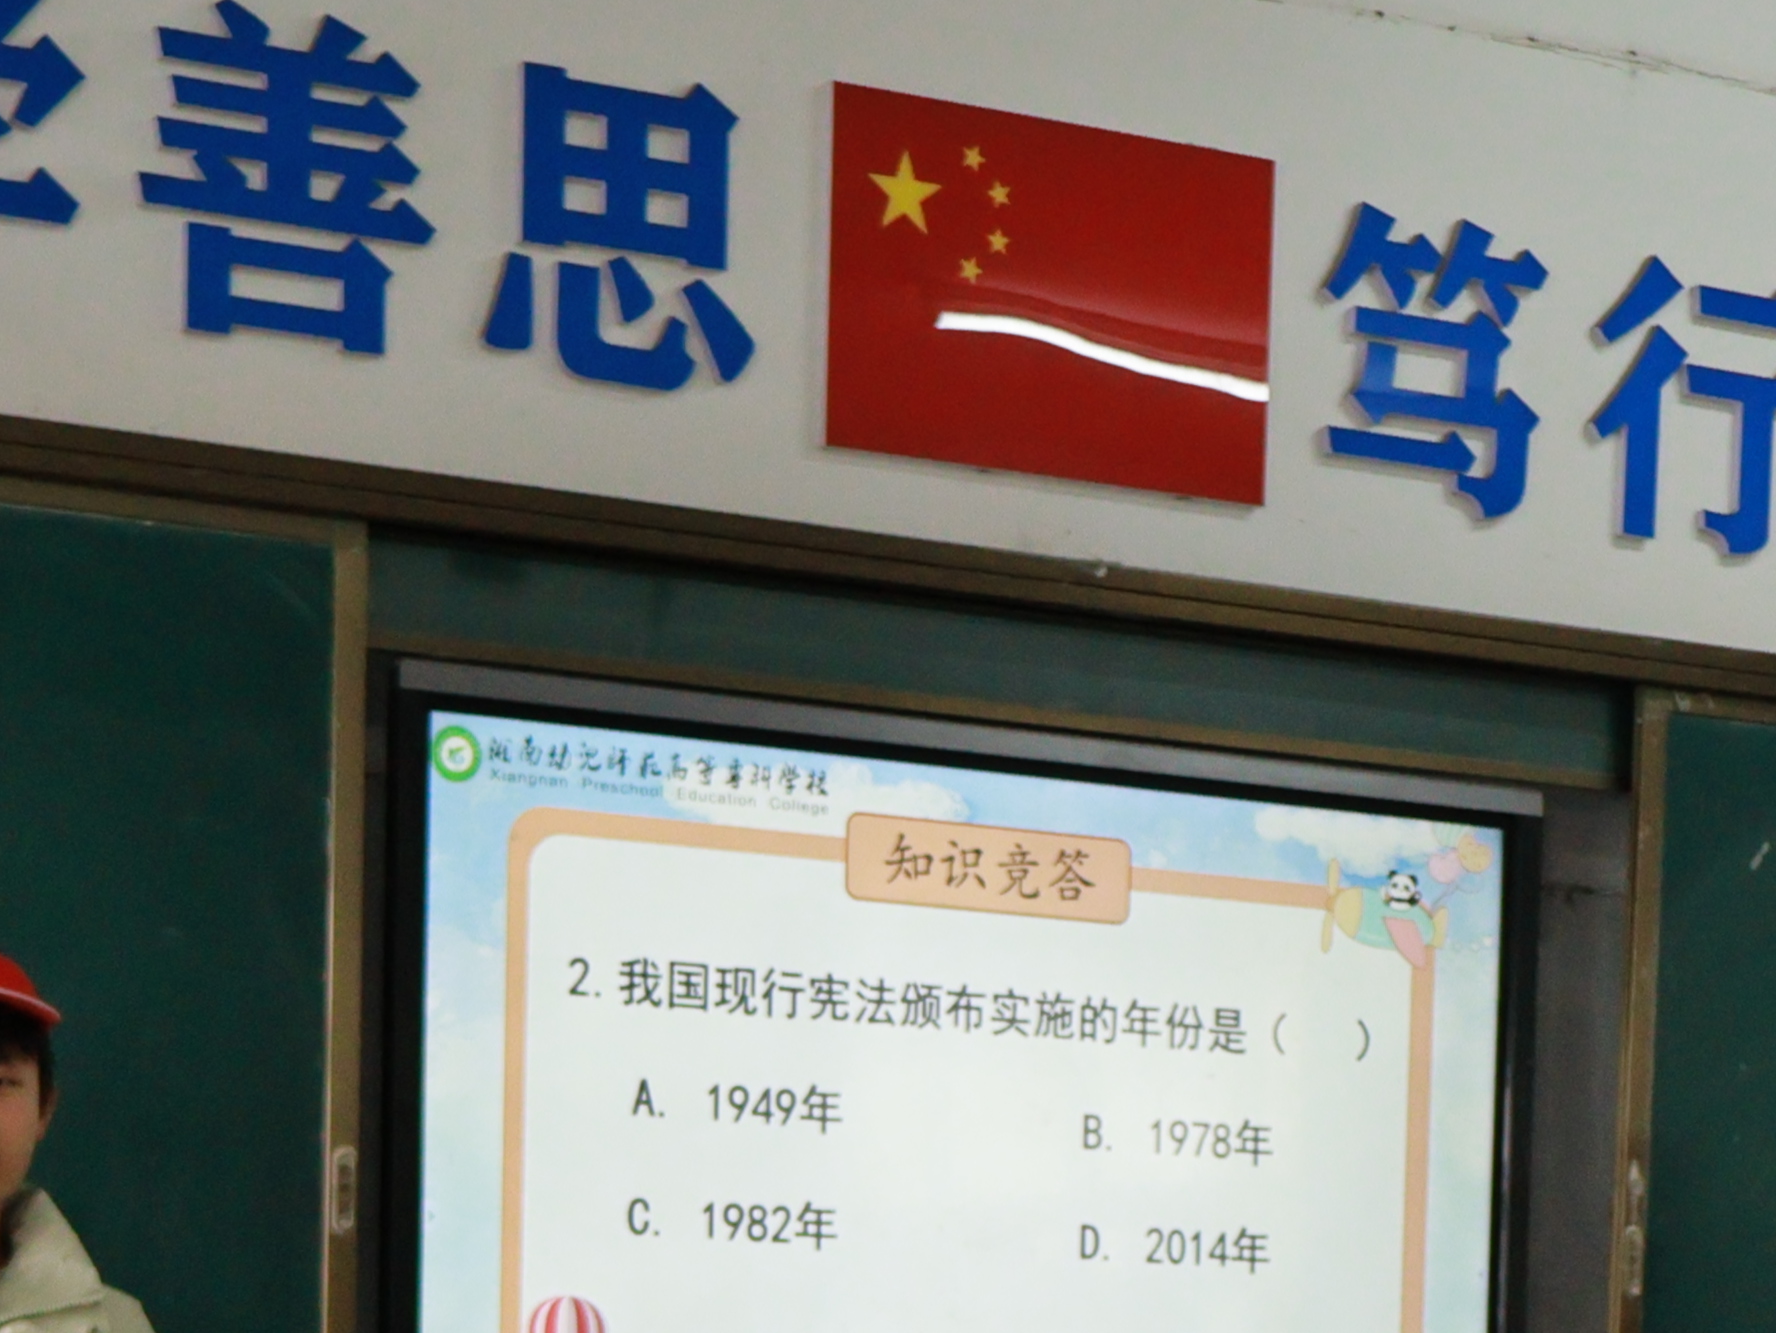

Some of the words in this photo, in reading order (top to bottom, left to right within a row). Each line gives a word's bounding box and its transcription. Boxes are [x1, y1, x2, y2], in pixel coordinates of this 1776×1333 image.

[490, 768, 569, 788] Xiangnan
[581, 777, 664, 798] Preschool
[677, 788, 757, 808] Education
[769, 797, 830, 816] College
[885, 833, 1096, 901] 知识竞答
[708, 1084, 843, 1135] 1949年
[1150, 1119, 1274, 1168] 1978年
[702, 1201, 838, 1251] 1982年
[1145, 1227, 1271, 1275] 2014年
